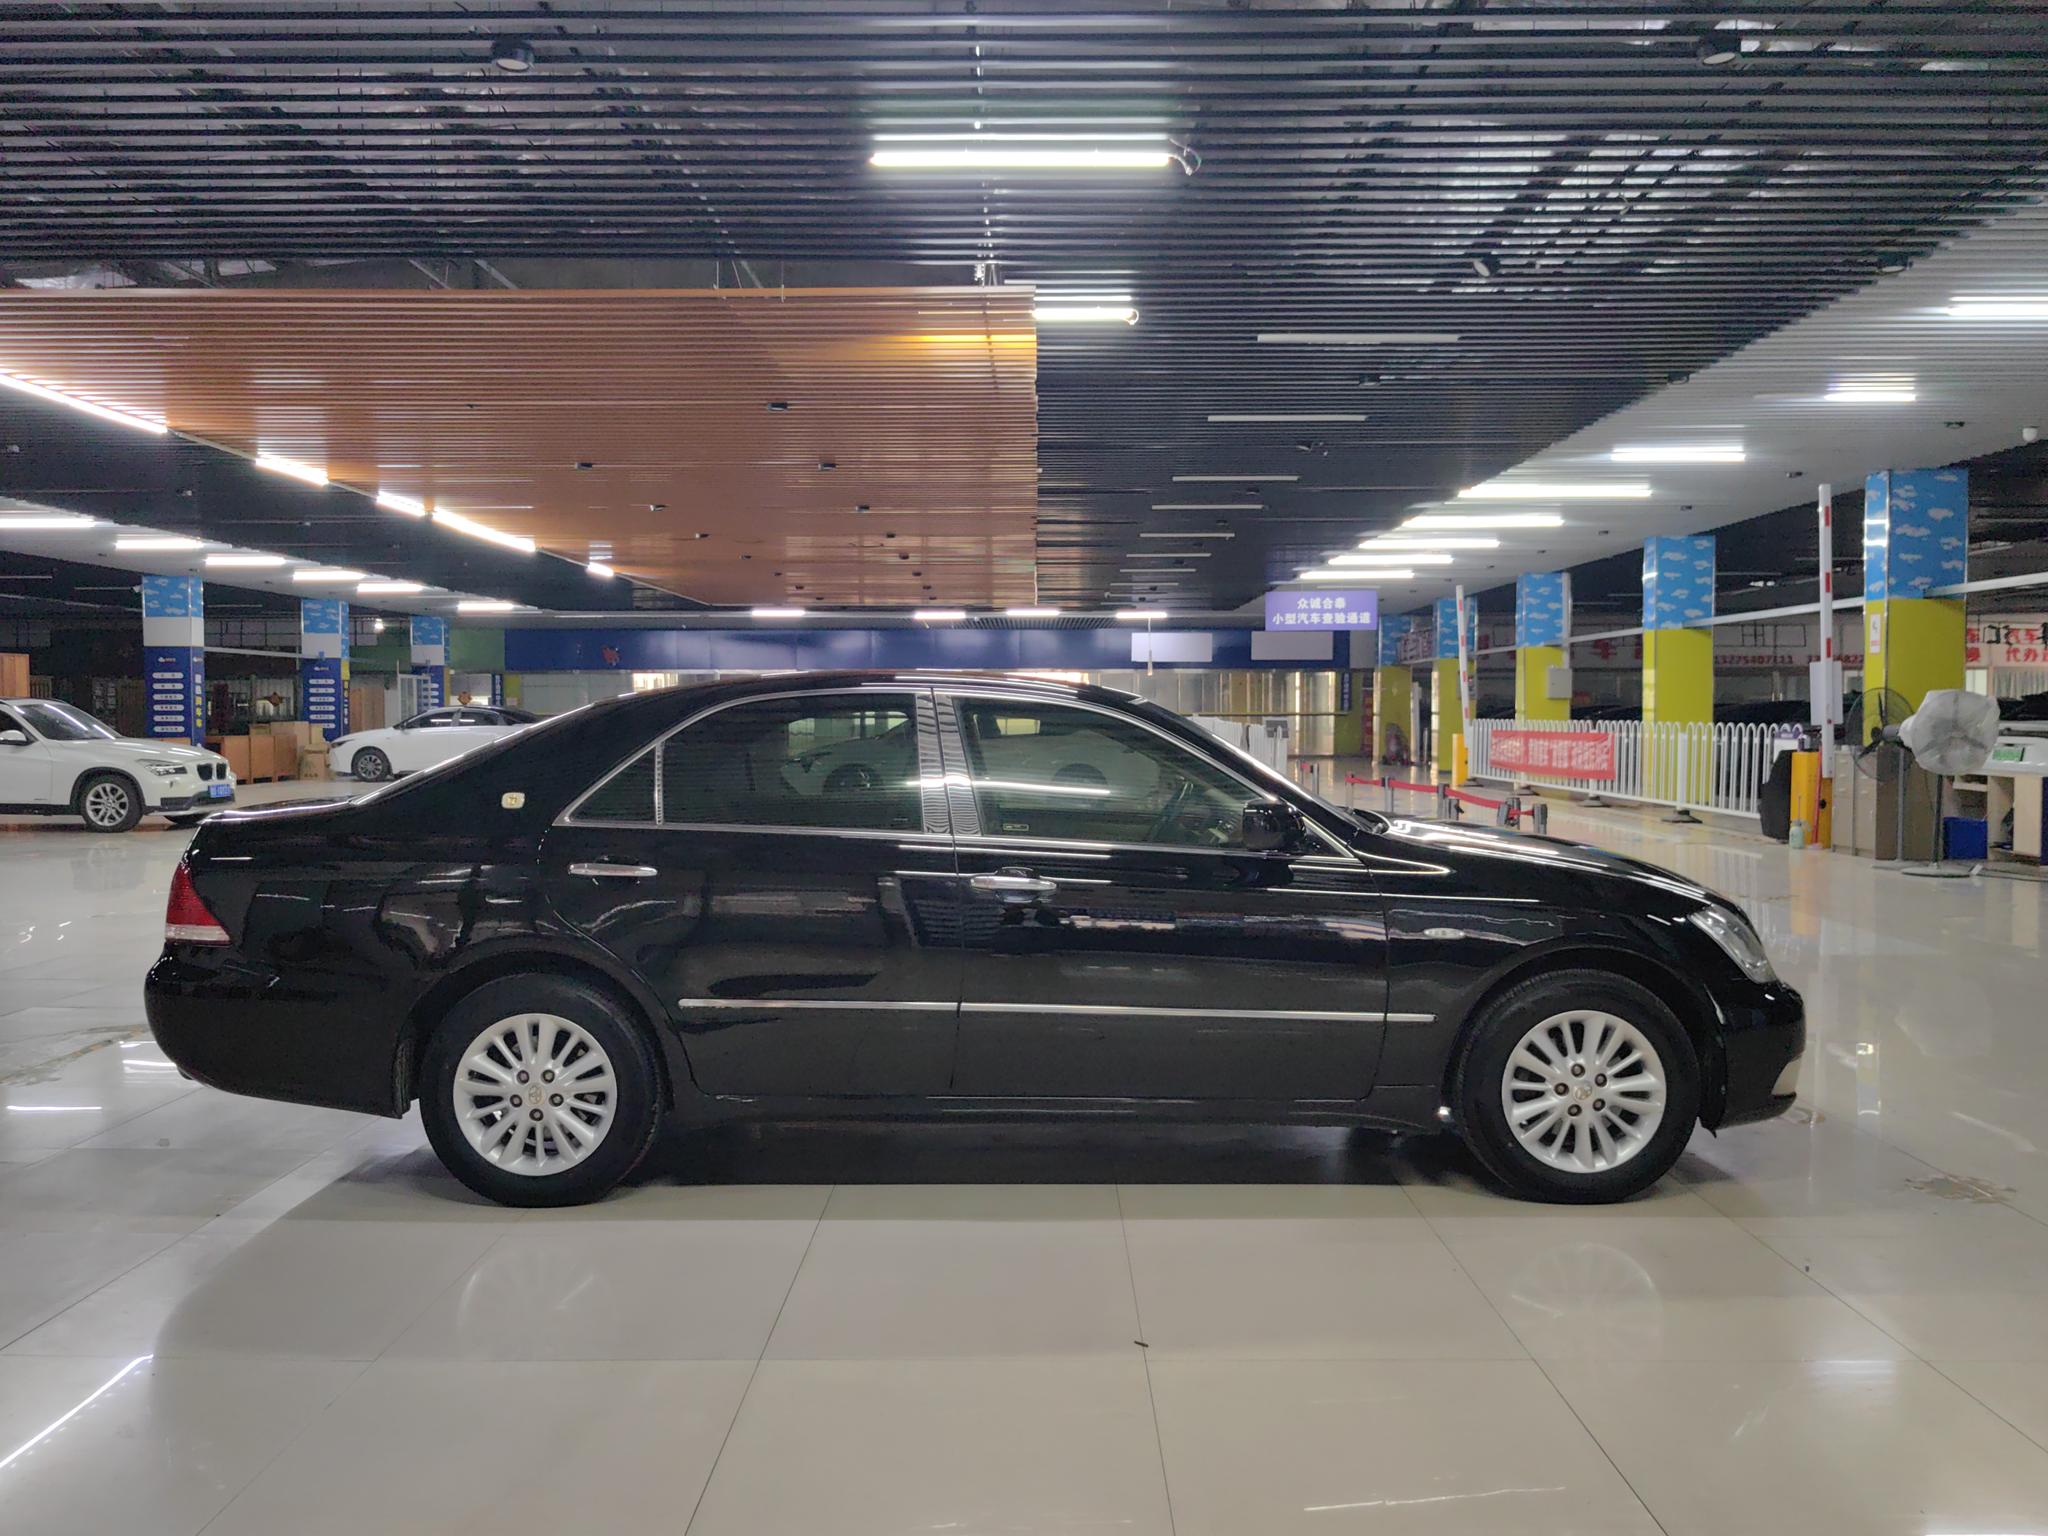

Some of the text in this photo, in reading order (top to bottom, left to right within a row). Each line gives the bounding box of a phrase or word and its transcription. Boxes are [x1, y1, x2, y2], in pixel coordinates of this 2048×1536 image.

[1272, 611, 1371, 625] 小型汽车查验通道
